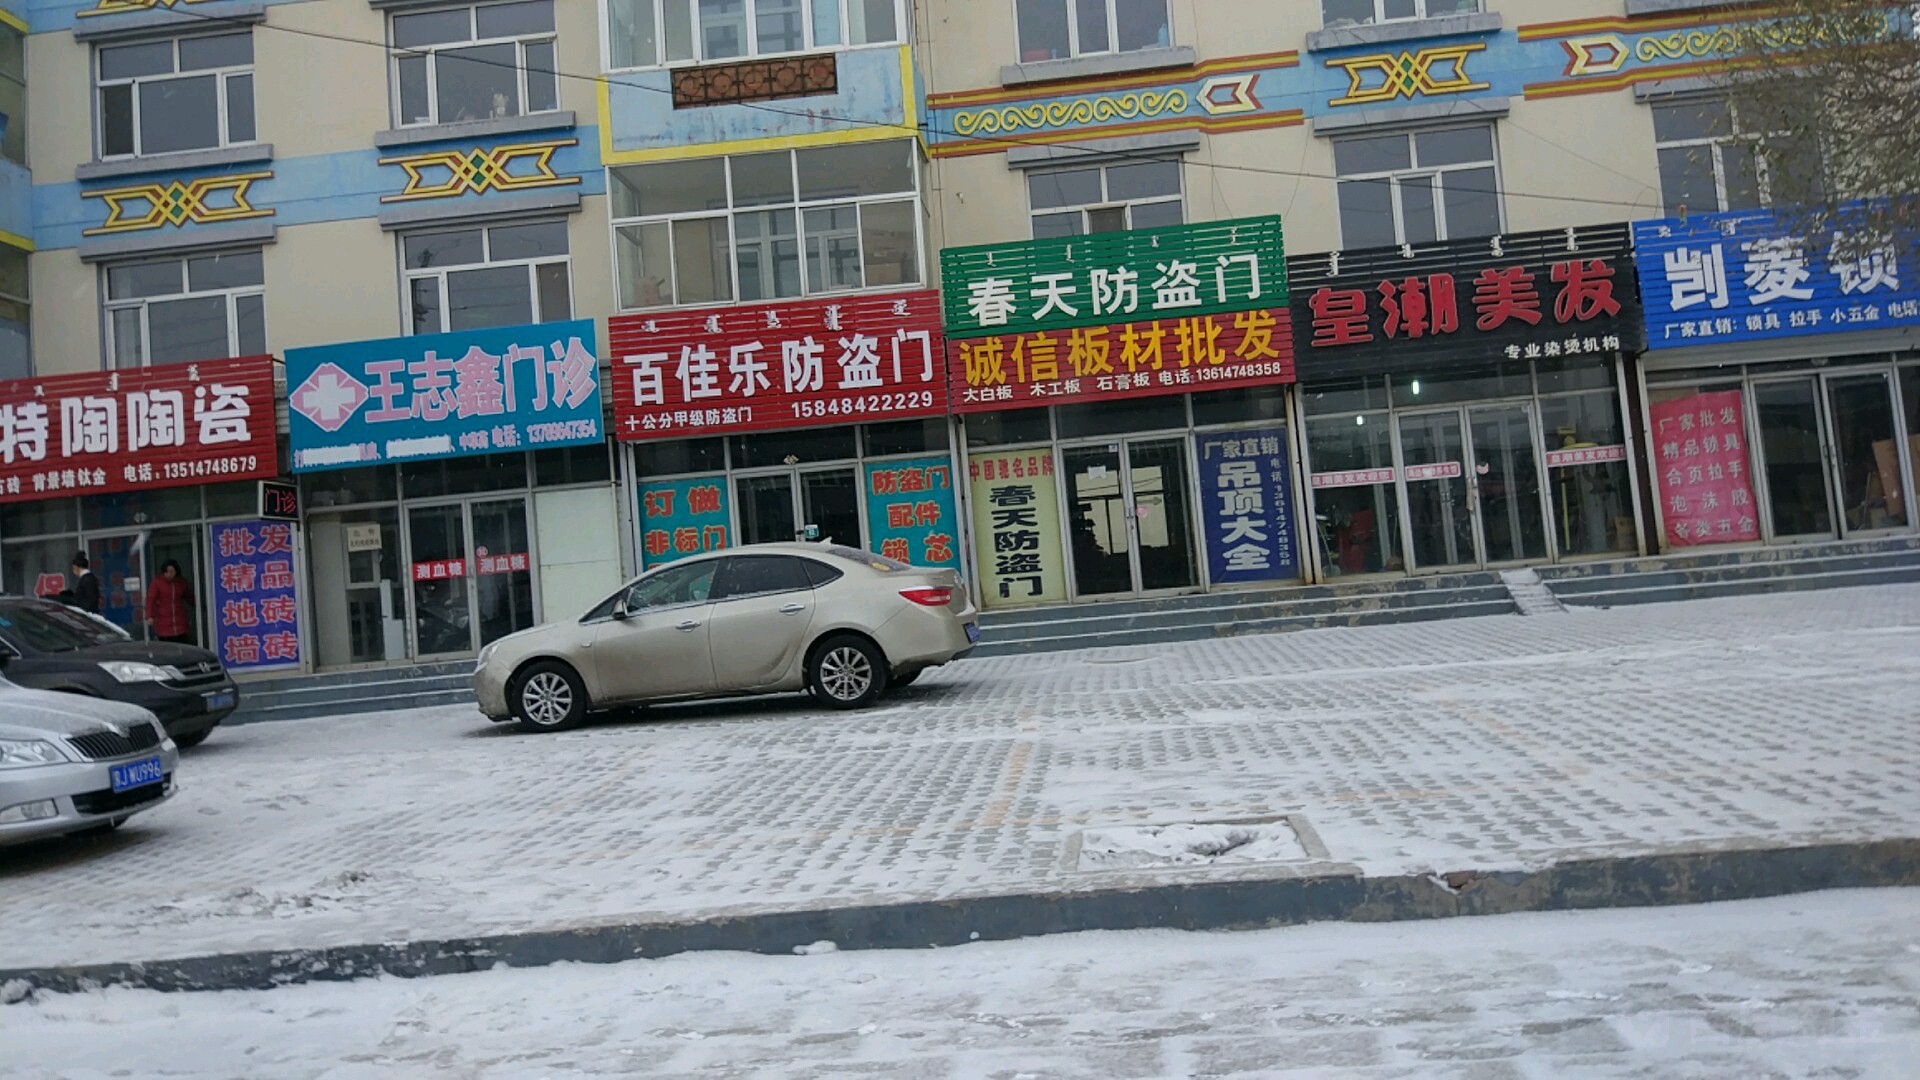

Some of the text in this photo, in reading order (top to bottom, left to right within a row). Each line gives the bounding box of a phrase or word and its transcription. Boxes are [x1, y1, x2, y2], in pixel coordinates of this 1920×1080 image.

[967, 254, 1261, 327] 春天防盗门
[1308, 259, 1621, 347] 皇潮美发
[1746, 315, 1780, 331] 锁具
[1789, 308, 1823, 328] 拉手
[1830, 304, 1880, 325] 小五金
[959, 310, 1280, 387] 诚信板材批发
[1504, 335, 1620, 359] 专业染烫机构
[364, 336, 599, 424] 王志鑫门诊
[623, 328, 934, 406] 百佳乐防盗门
[963, 385, 1013, 403] 大白板
[1030, 378, 1081, 397] 木工板
[1096, 371, 1150, 391] 石膏板
[0, 383, 251, 464] 特陶陶瓷
[625, 391, 933, 432] 十公分甲级防盗门 15848422229
[1660, 407, 1737, 434] 厂家批发
[1204, 436, 1280, 461] 厂家直销
[1662, 433, 1741, 459] 精品锁具
[0, 475, 21, 495] 砖
[32, 467, 107, 492] 背景墙钛金
[872, 466, 950, 495] 防盗门
[969, 454, 1054, 482] 中国驰名品牌
[1667, 459, 1743, 486] 合页拉手
[265, 486, 297, 514] 门诊
[645, 485, 721, 517] 订做
[887, 501, 941, 528] 配件
[1670, 487, 1748, 512] 泡沫胶
[1217, 460, 1272, 571] 吊顶大全
[1674, 516, 1754, 539] 各类五金
[219, 524, 292, 557] 批发
[645, 525, 727, 556] 非标门
[881, 534, 953, 564] 锁芯
[989, 485, 1043, 598] 春天防盗门
[221, 561, 294, 593] 精品
[417, 561, 463, 578] 测血糖
[480, 554, 526, 573] 测血糖
[222, 595, 296, 627] 地砖
[224, 631, 298, 664] 墙砖
